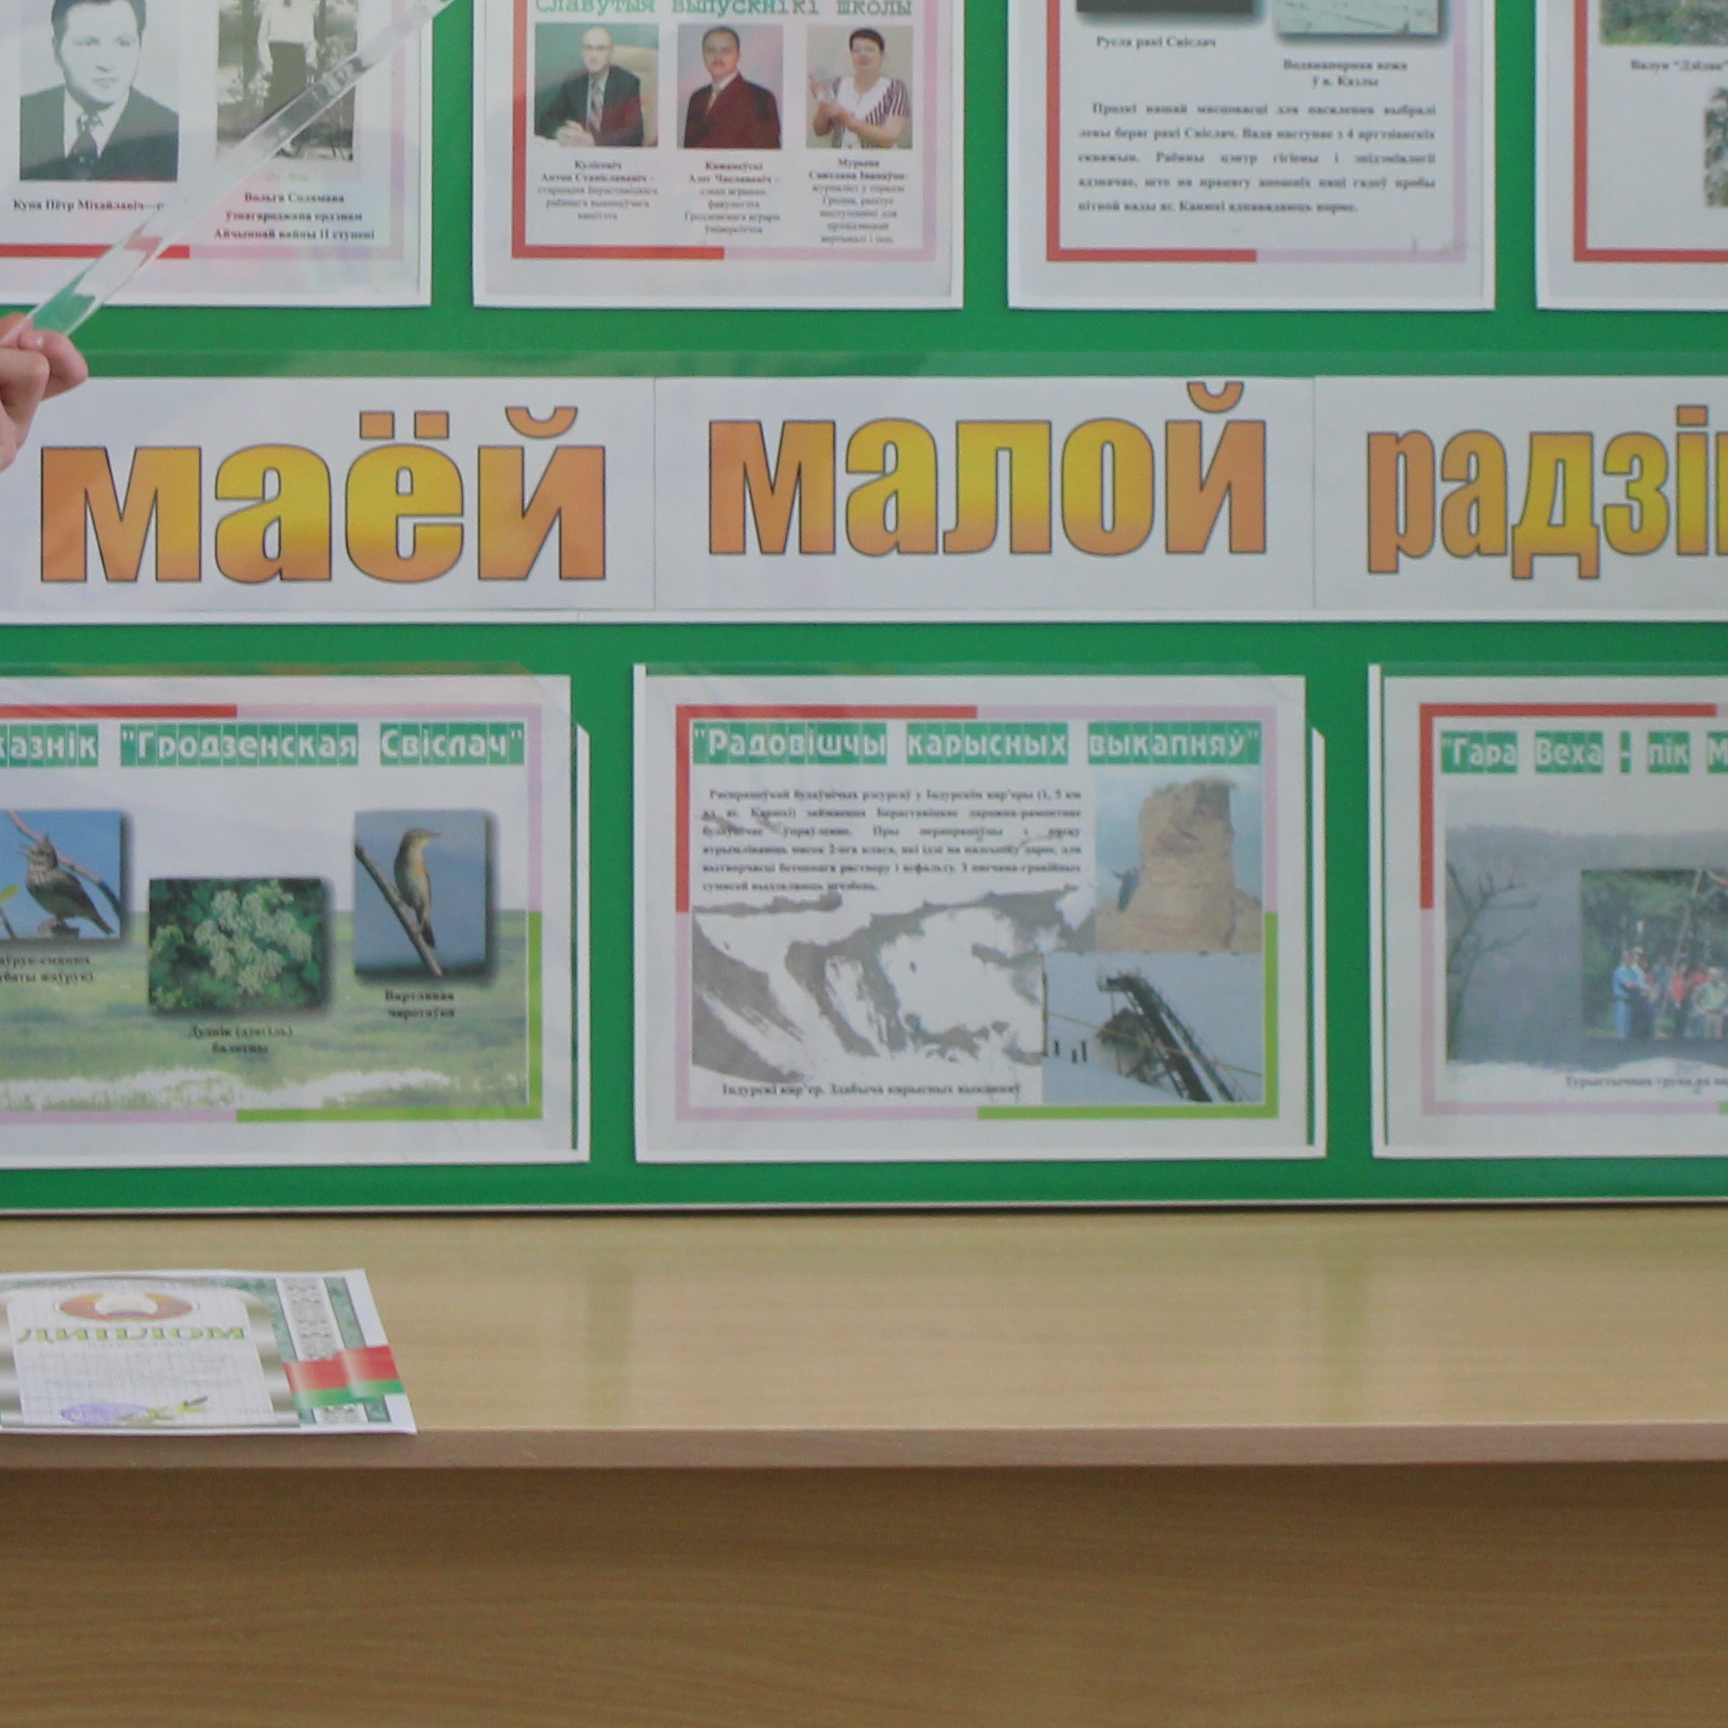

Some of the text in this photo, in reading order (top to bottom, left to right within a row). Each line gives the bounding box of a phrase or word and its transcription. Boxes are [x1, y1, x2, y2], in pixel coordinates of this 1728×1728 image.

[38, 404, 608, 585] маёй
[706, 378, 1269, 559] малой
[123, 727, 359, 762] "Гродзенская
[380, 728, 524, 761] Свіслач"
[693, 725, 1260, 760] "Радовішчы карысных выкапняў"
[1535, 738, 1603, 765] Веха
[15, 1326, 246, 1345] ДИПЛОМ
